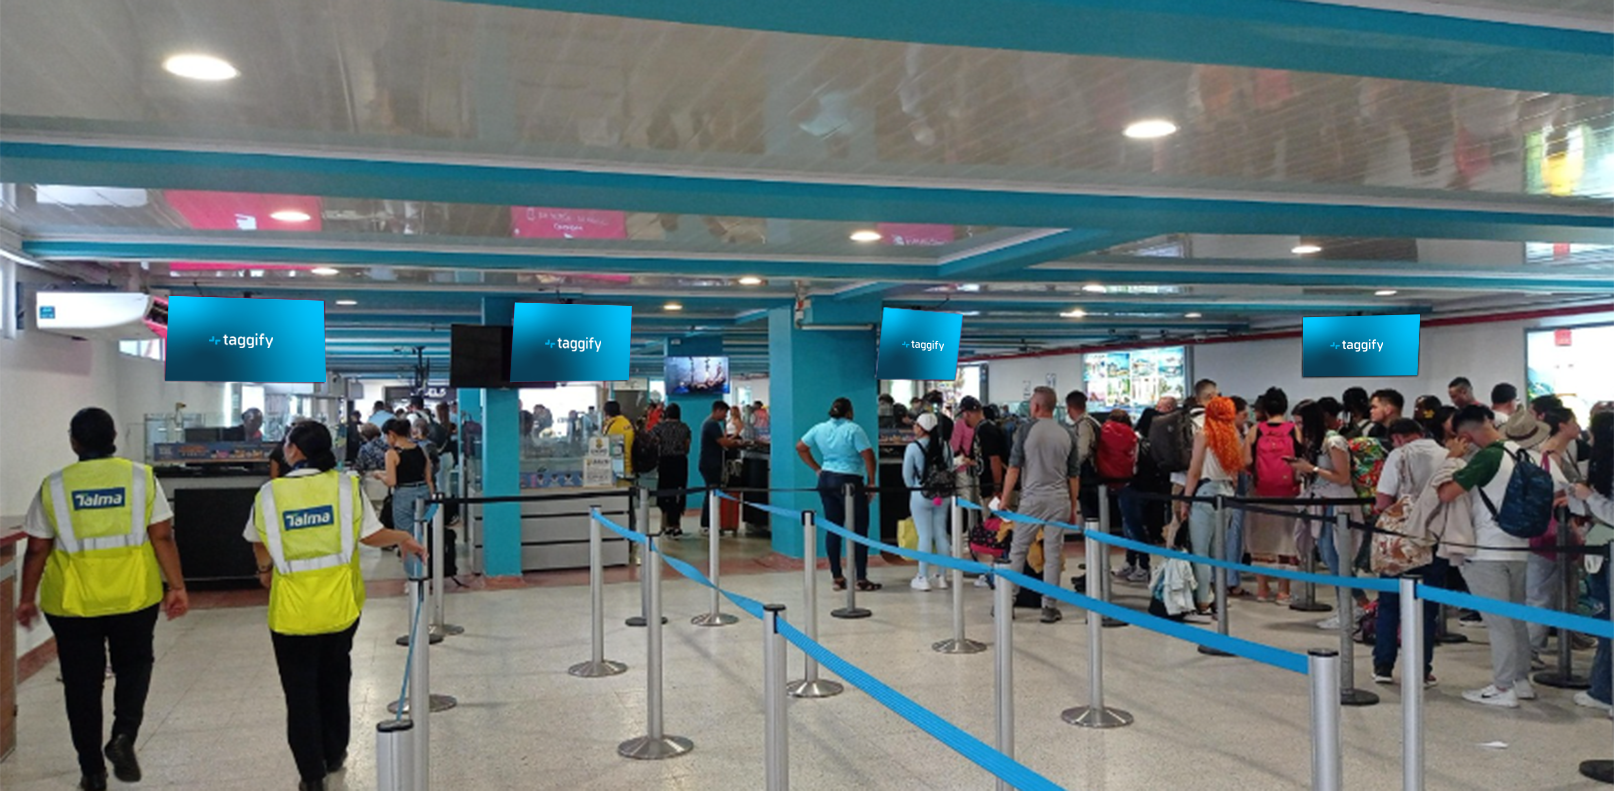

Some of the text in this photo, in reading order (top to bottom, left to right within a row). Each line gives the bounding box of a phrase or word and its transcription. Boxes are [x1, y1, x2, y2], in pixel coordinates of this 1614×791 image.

[223, 332, 274, 349] taggify
[557, 336, 602, 352] taggify
[911, 340, 945, 352] taggify
[1341, 339, 1384, 353] taggify
[74, 493, 123, 506] Talma
[286, 511, 331, 527] Talma
